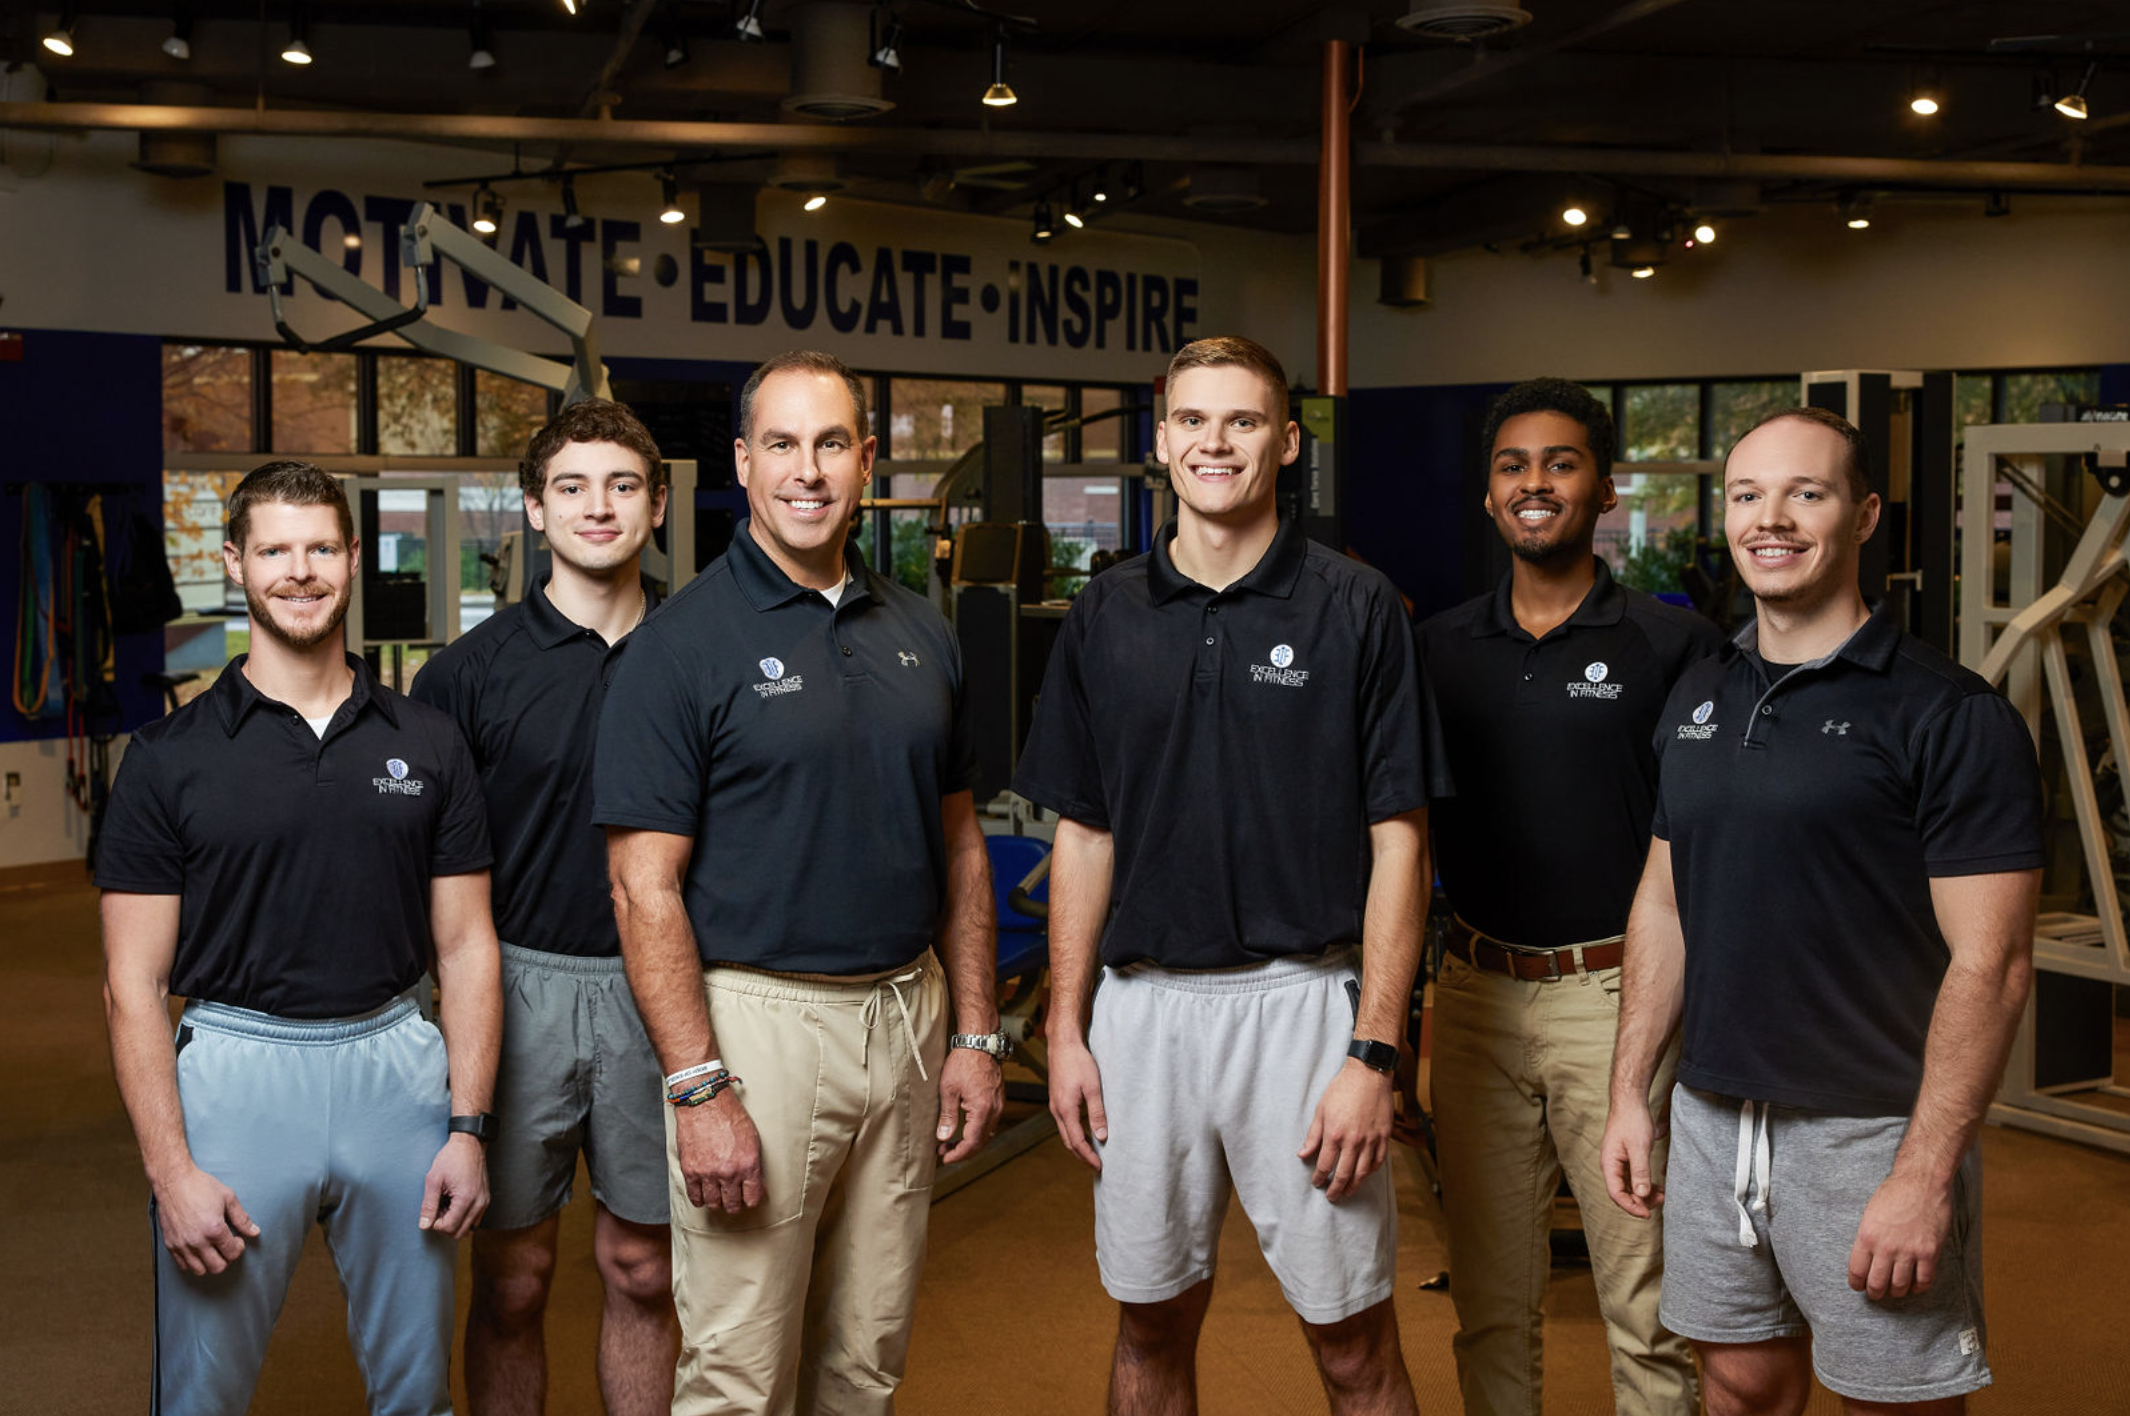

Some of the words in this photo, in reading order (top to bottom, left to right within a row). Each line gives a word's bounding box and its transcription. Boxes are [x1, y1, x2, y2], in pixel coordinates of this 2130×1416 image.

[224, 181, 643, 318] MOTIVATE
[690, 227, 972, 341] EDUCATE
[1007, 259, 1198, 353] INSPIRE
[1250, 664, 1309, 680] EXCELLENCE
[753, 675, 803, 691] EXCELLENCE
[1263, 673, 1304, 687] FITNESS
[769, 683, 802, 696] FITNESS
[1566, 682, 1623, 693] EXCELLENCE
[1580, 689, 1618, 700] FITNESS
[372, 777, 424, 789] EXCELLENCE
[389, 785, 421, 797] FITNESS
